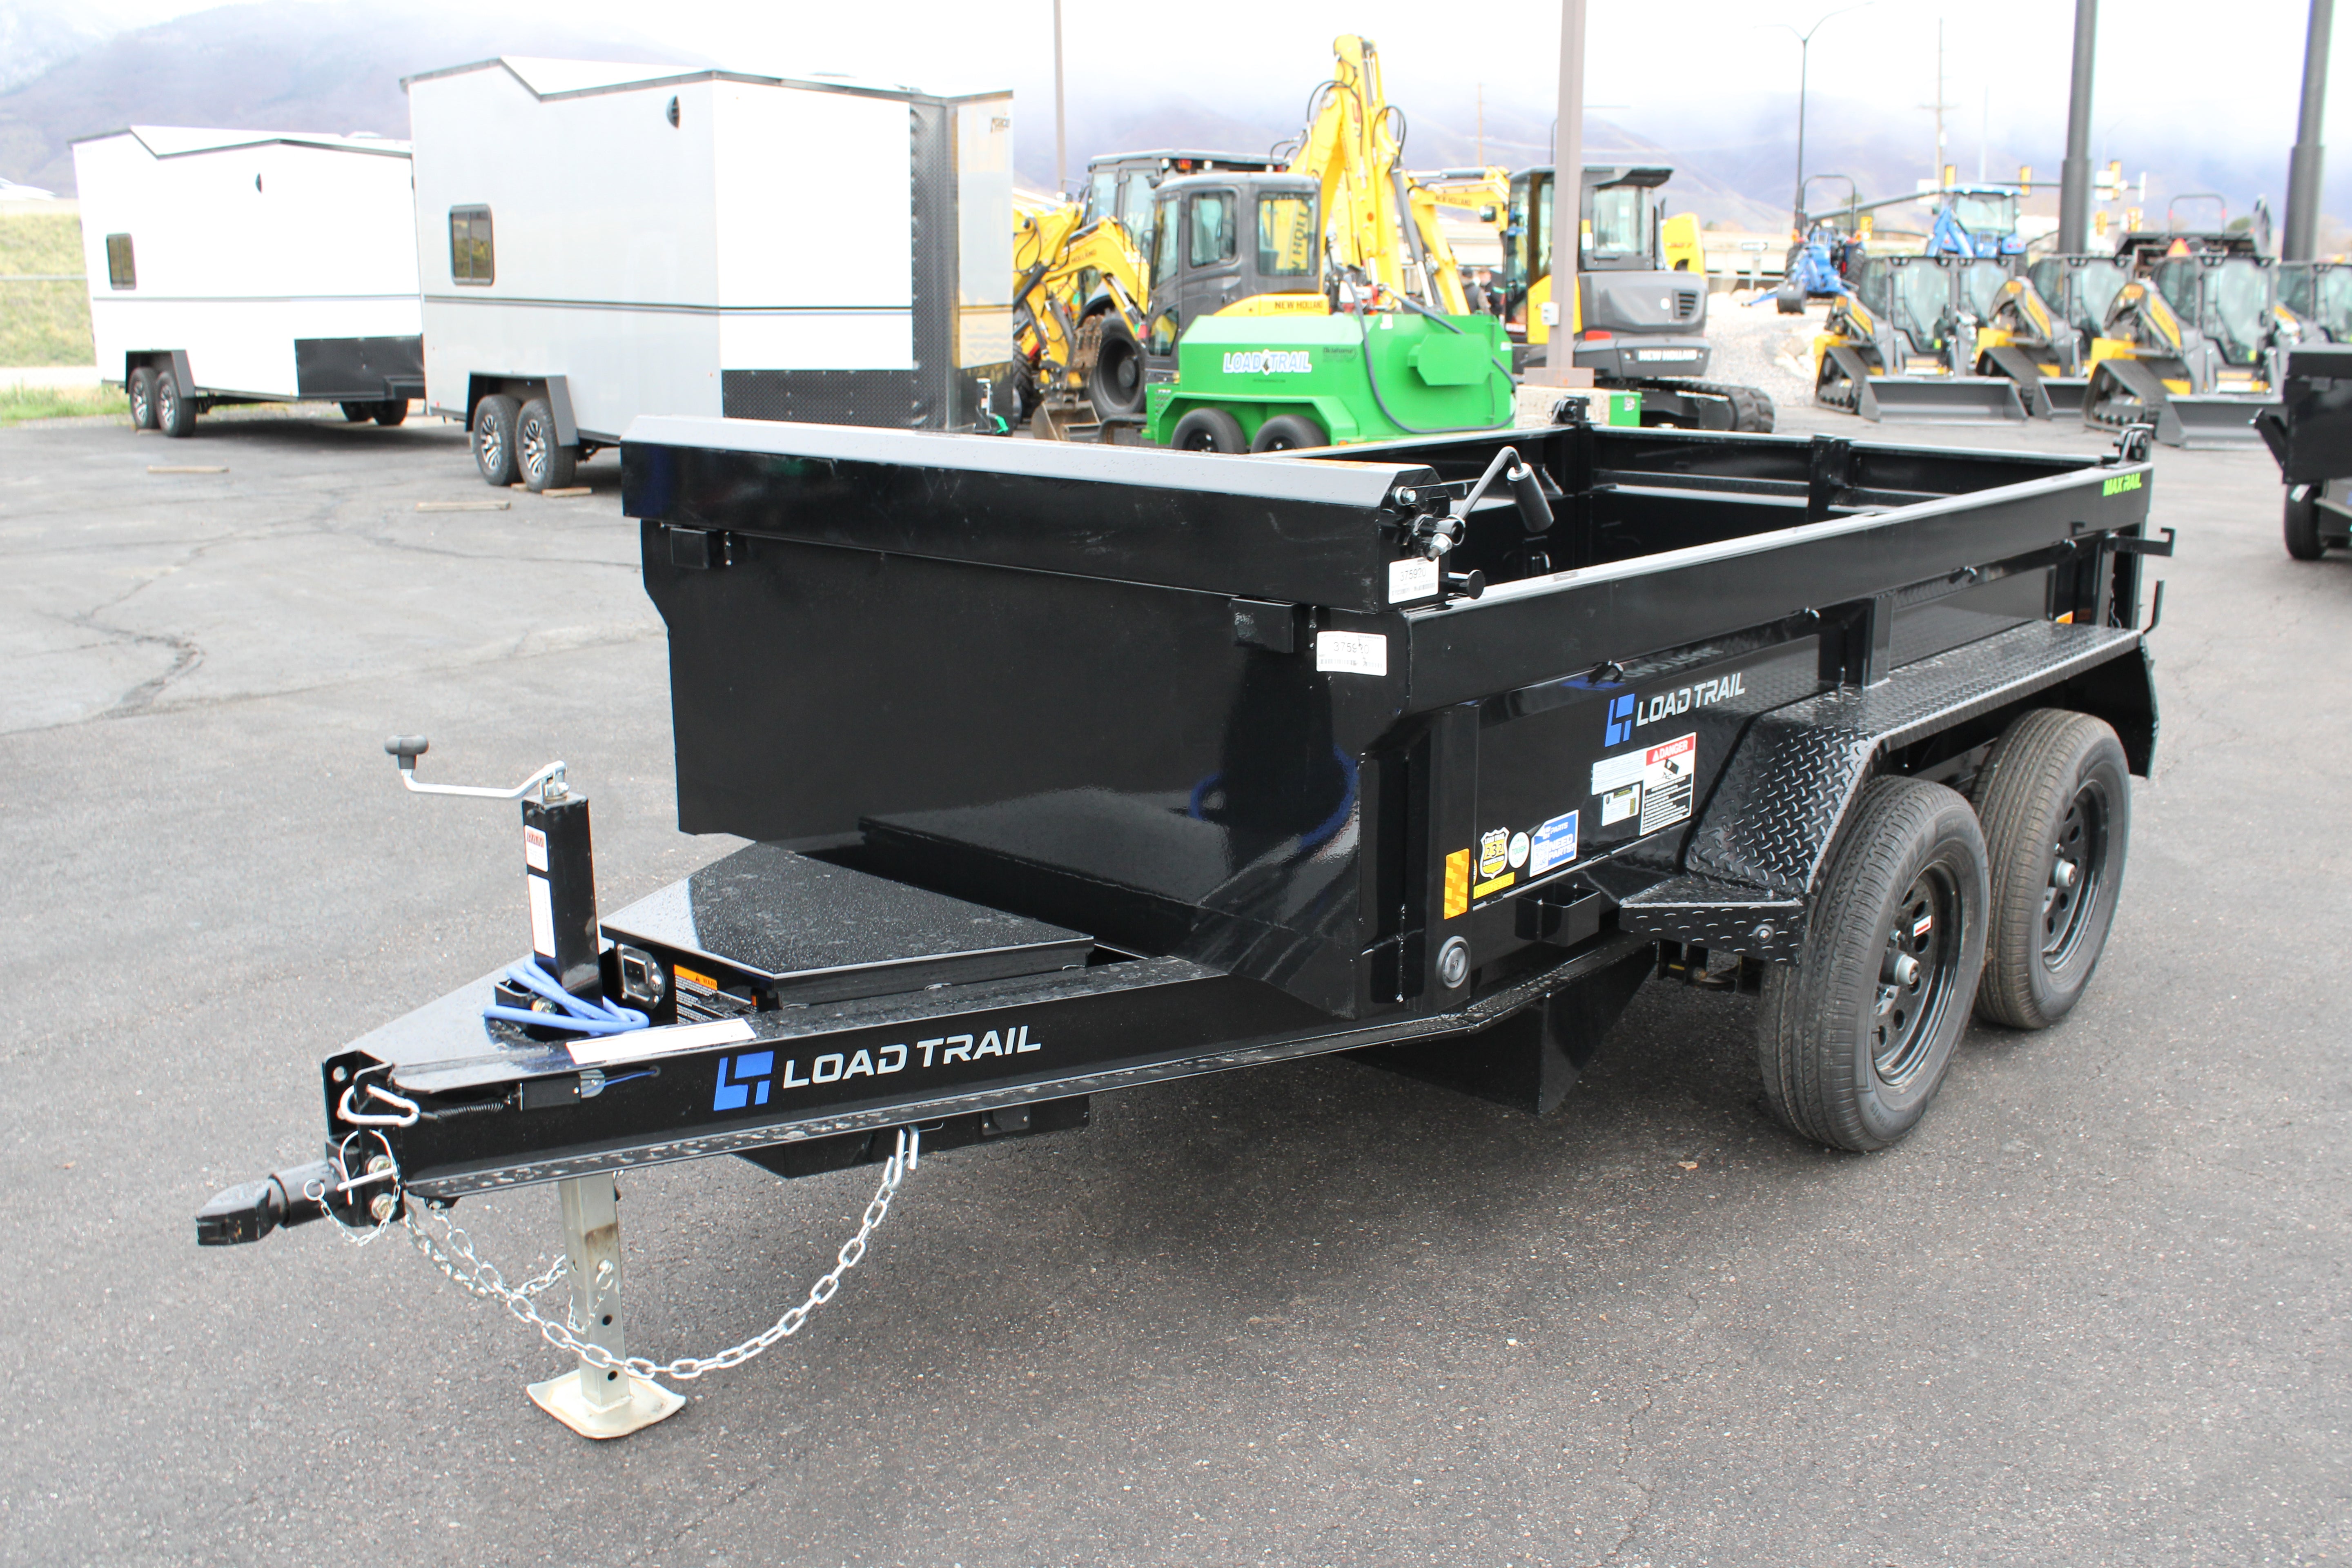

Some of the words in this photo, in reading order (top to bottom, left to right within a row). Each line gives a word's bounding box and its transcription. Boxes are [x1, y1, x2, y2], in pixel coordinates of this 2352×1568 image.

[1274, 301, 1294, 309] NEW
[1296, 301, 1323, 309] HOLLAND
[1223, 352, 1262, 373] LOAD
[1270, 351, 1312, 372] TRAIL
[1639, 350, 1662, 361] NEW
[1662, 350, 1697, 361] HOLLAND
[2103, 476, 2123, 497] MAX
[2123, 472, 2142, 491] RAIL
[1400, 567, 1427, 582] 375920
[1636, 688, 1691, 727] LOAD
[1695, 673, 1746, 708] TRAIL
[1659, 740, 1688, 759] DANGER
[1550, 822, 1569, 835] PARTS
[1486, 843, 1503, 857] 232
[1512, 844, 1527, 855] TOUGH
[1549, 833, 1574, 852] NEED
[1548, 842, 1576, 861] PARTS?
[702, 977, 717, 987] WARN
[783, 1044, 908, 1089] LOAD
[917, 1025, 1041, 1068] TRAIL
